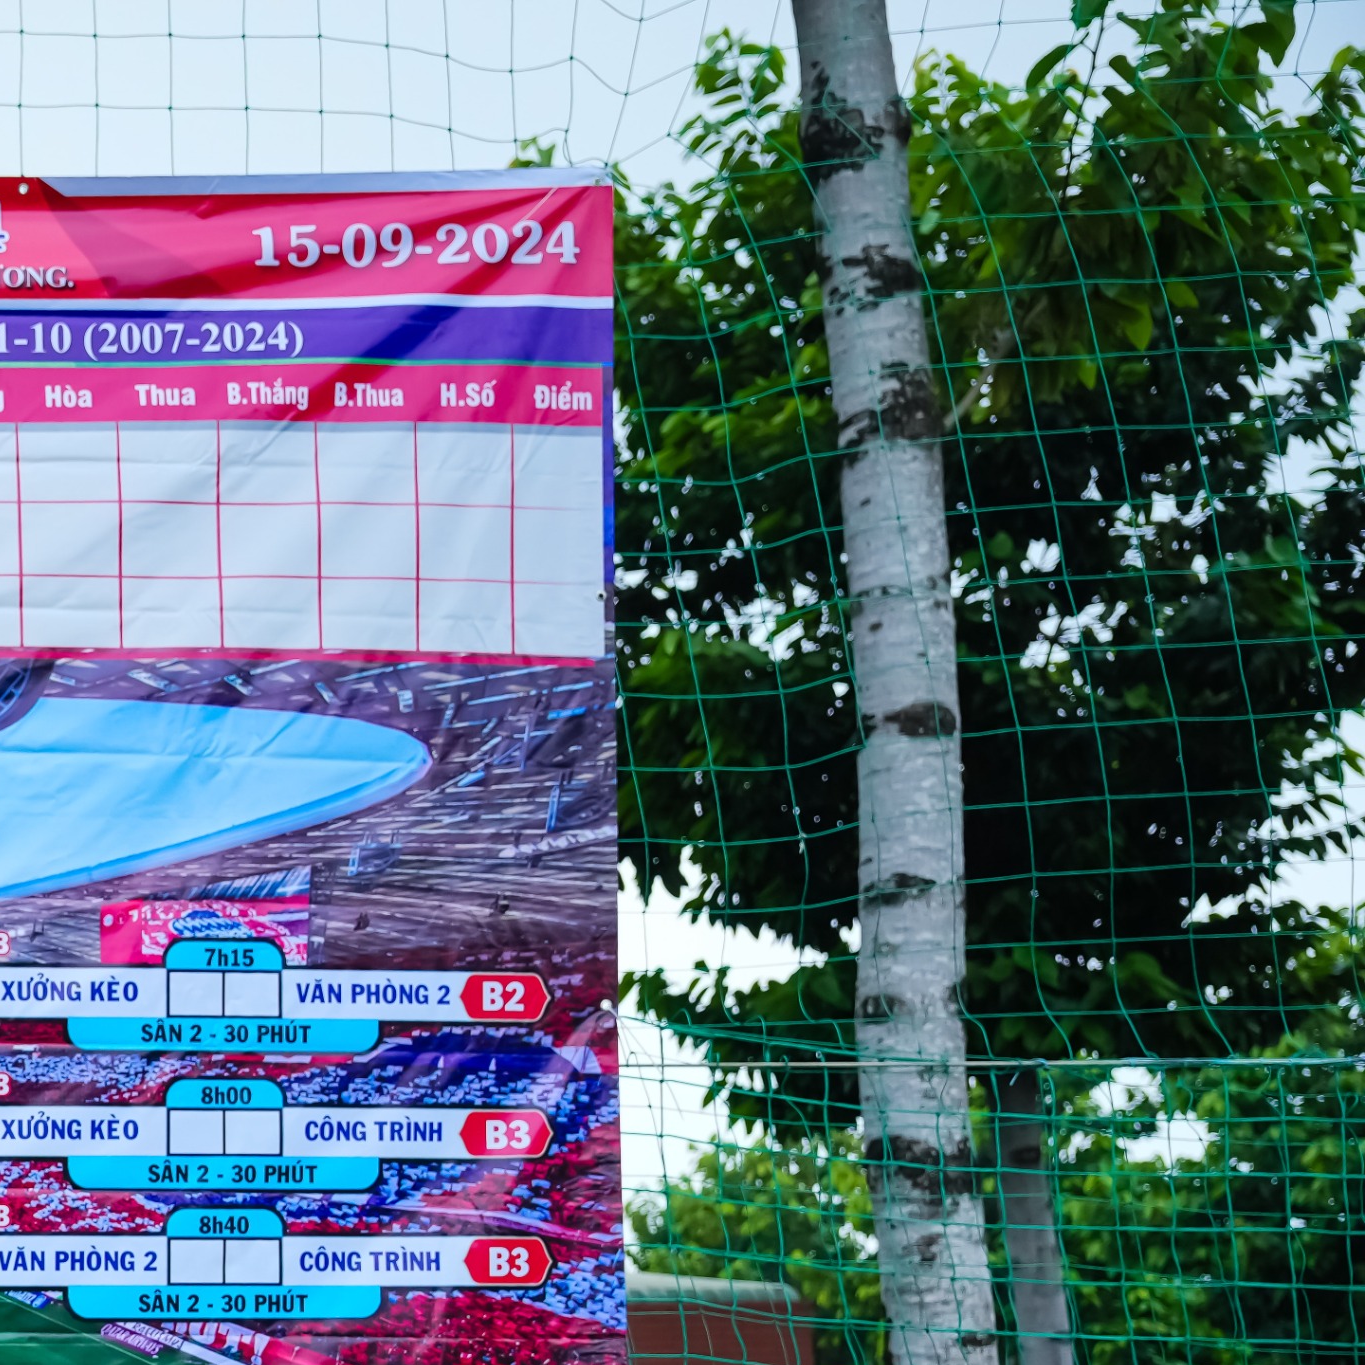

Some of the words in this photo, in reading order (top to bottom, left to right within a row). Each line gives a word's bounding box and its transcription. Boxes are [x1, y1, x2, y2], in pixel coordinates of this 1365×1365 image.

[251, 219, 580, 271] 15-09-2024
[82, 319, 305, 360] (2007-2024)
[198, 1216, 249, 1234] 8h40
